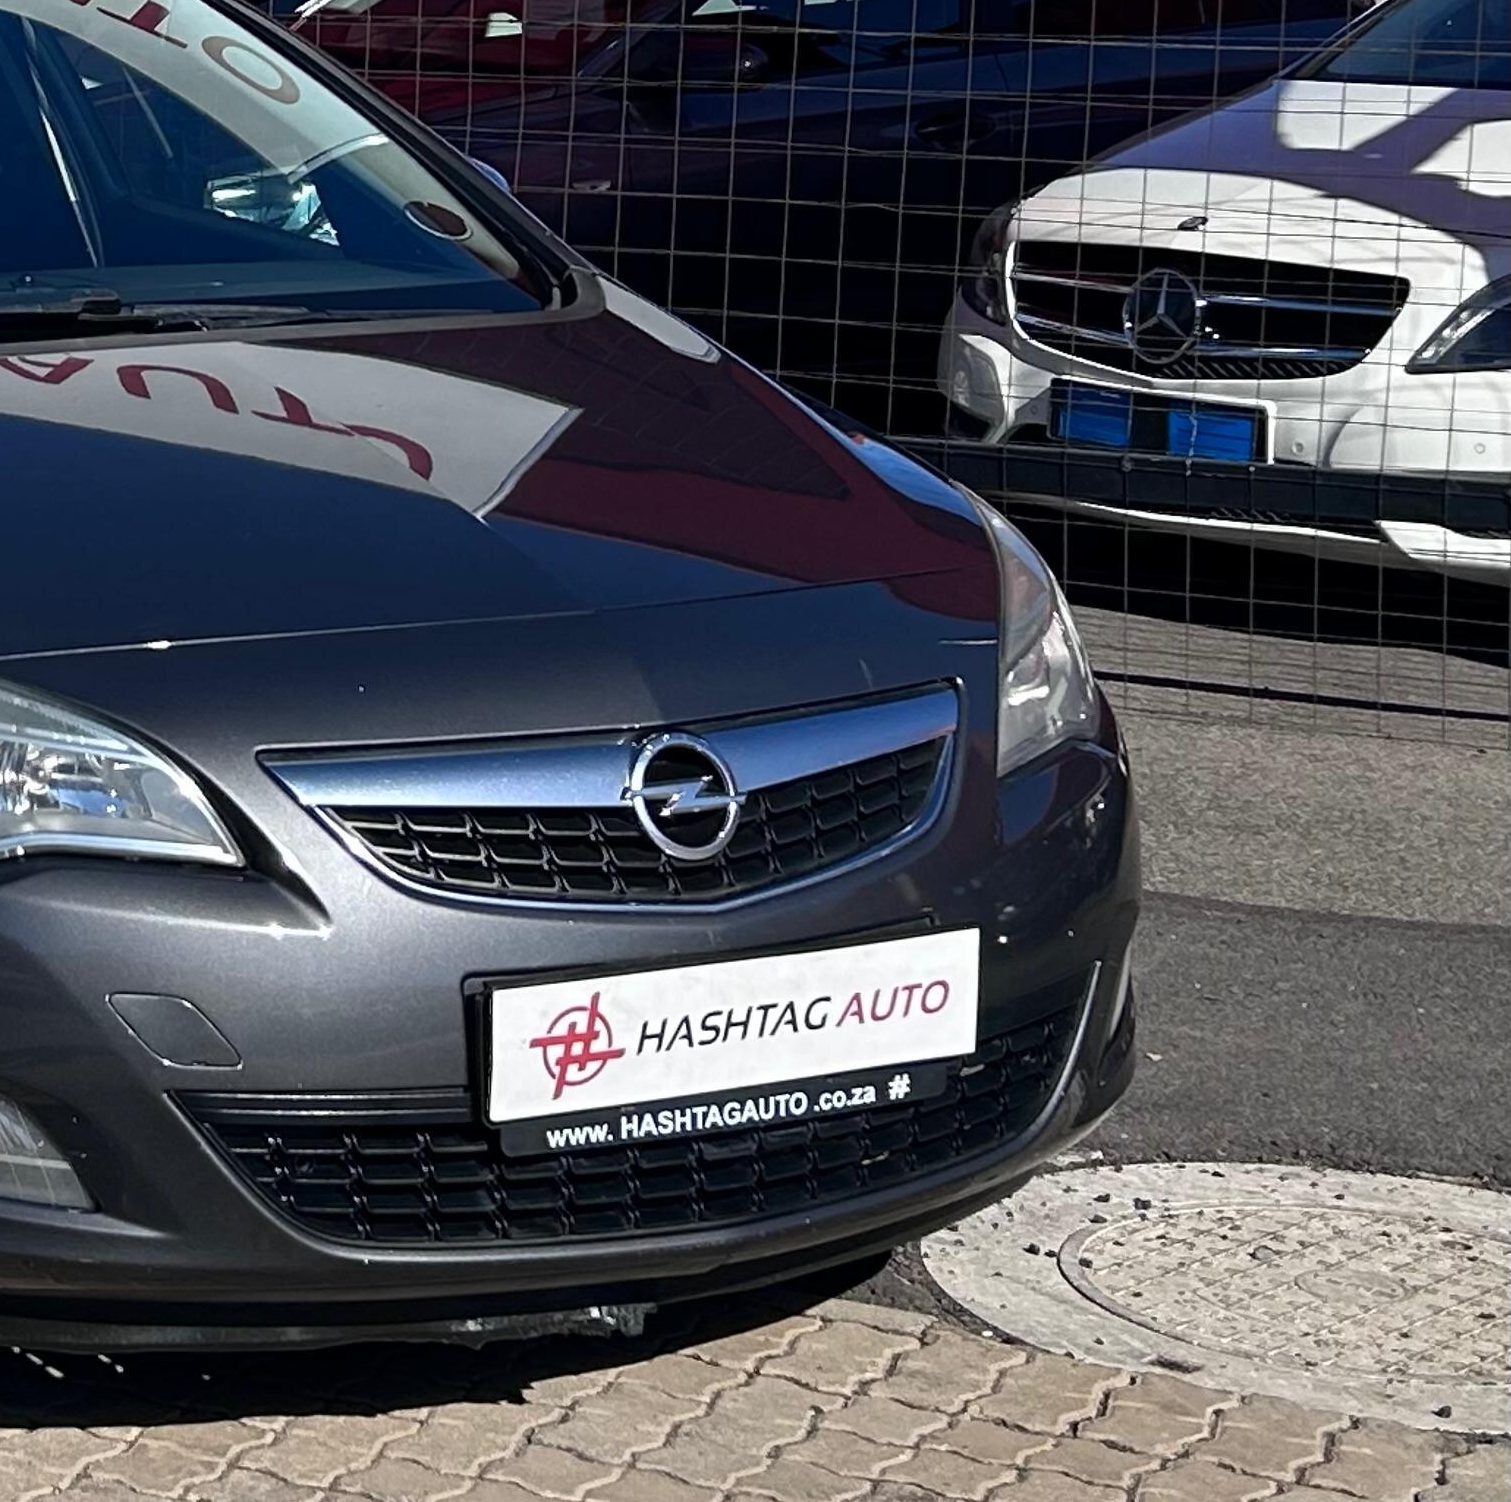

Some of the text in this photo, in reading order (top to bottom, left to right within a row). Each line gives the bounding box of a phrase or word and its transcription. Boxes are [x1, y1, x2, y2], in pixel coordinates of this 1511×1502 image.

[636, 979, 950, 1056] HASHTAG AUTO
[546, 1123, 614, 1149] www.
[620, 1091, 809, 1140] HASHTAGAUTO
[813, 1084, 877, 1112] .co.za
